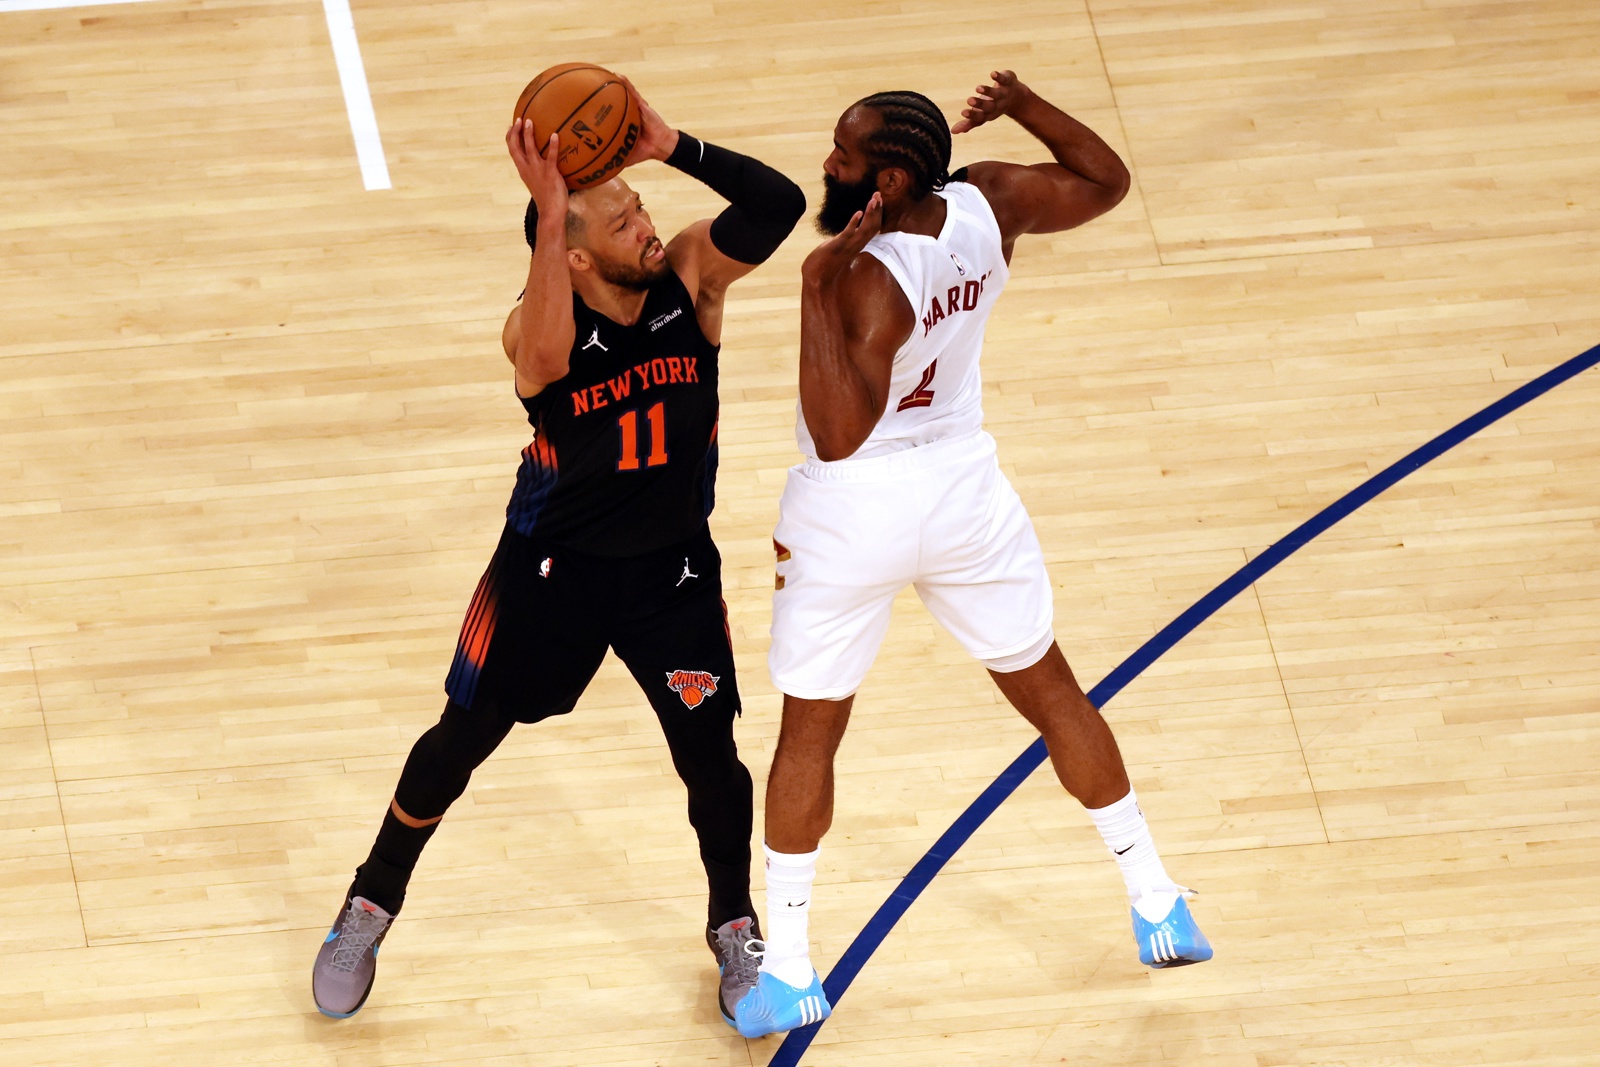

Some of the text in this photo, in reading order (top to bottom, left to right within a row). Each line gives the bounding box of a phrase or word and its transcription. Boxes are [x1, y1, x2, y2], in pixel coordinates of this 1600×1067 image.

[922, 270, 992, 338] HARD
[571, 356, 700, 417] NEW YORK
[616, 400, 669, 472] 11
[669, 671, 717, 691] KNICKS
